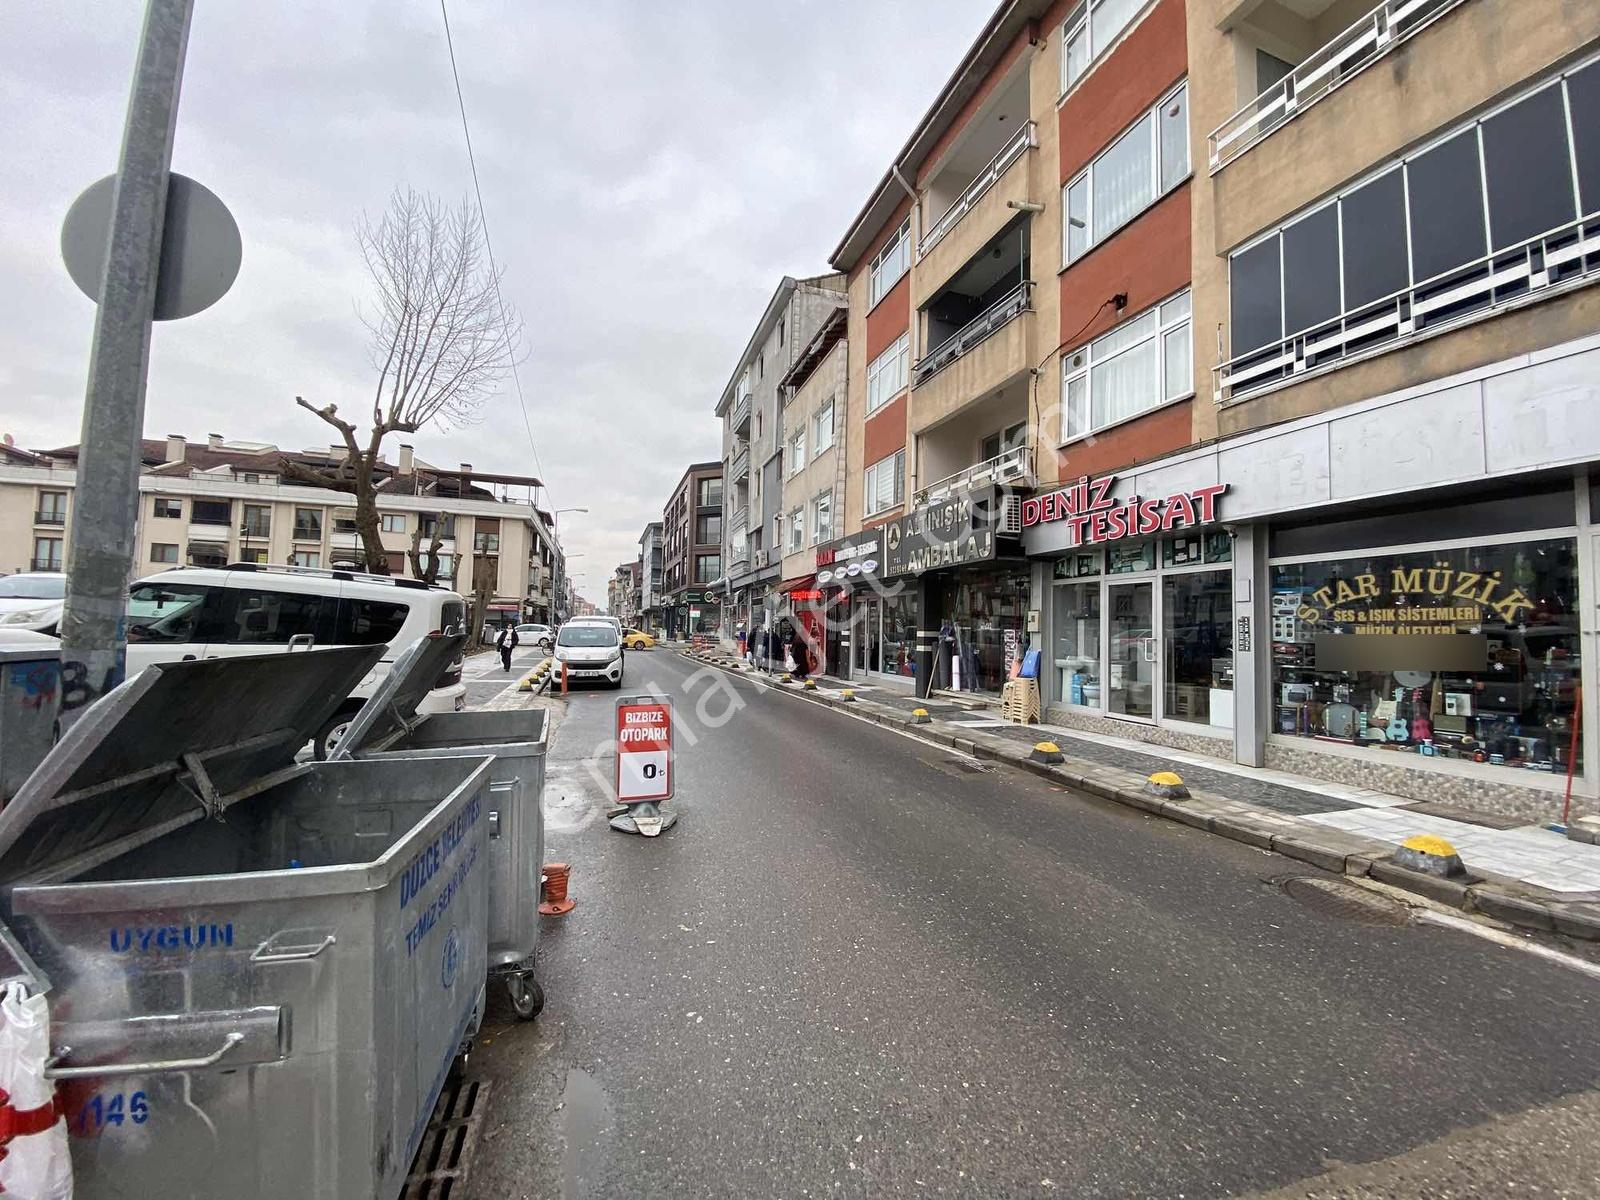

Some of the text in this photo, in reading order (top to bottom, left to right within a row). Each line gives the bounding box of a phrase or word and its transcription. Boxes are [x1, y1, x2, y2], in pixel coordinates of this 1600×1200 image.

[1022, 475, 1116, 527] DENİZ
[1066, 483, 1227, 546] TESİSAT
[908, 532, 991, 571] AMBALAJ
[1297, 561, 1535, 625] STAR MÜZİK
[1333, 610, 1355, 622] SES
[1357, 611, 1367, 621] &
[1398, 605, 1480, 621] SİSTEMLERİ
[620, 727, 668, 742] OTOPARK
[109, 922, 234, 952] UYGUN
